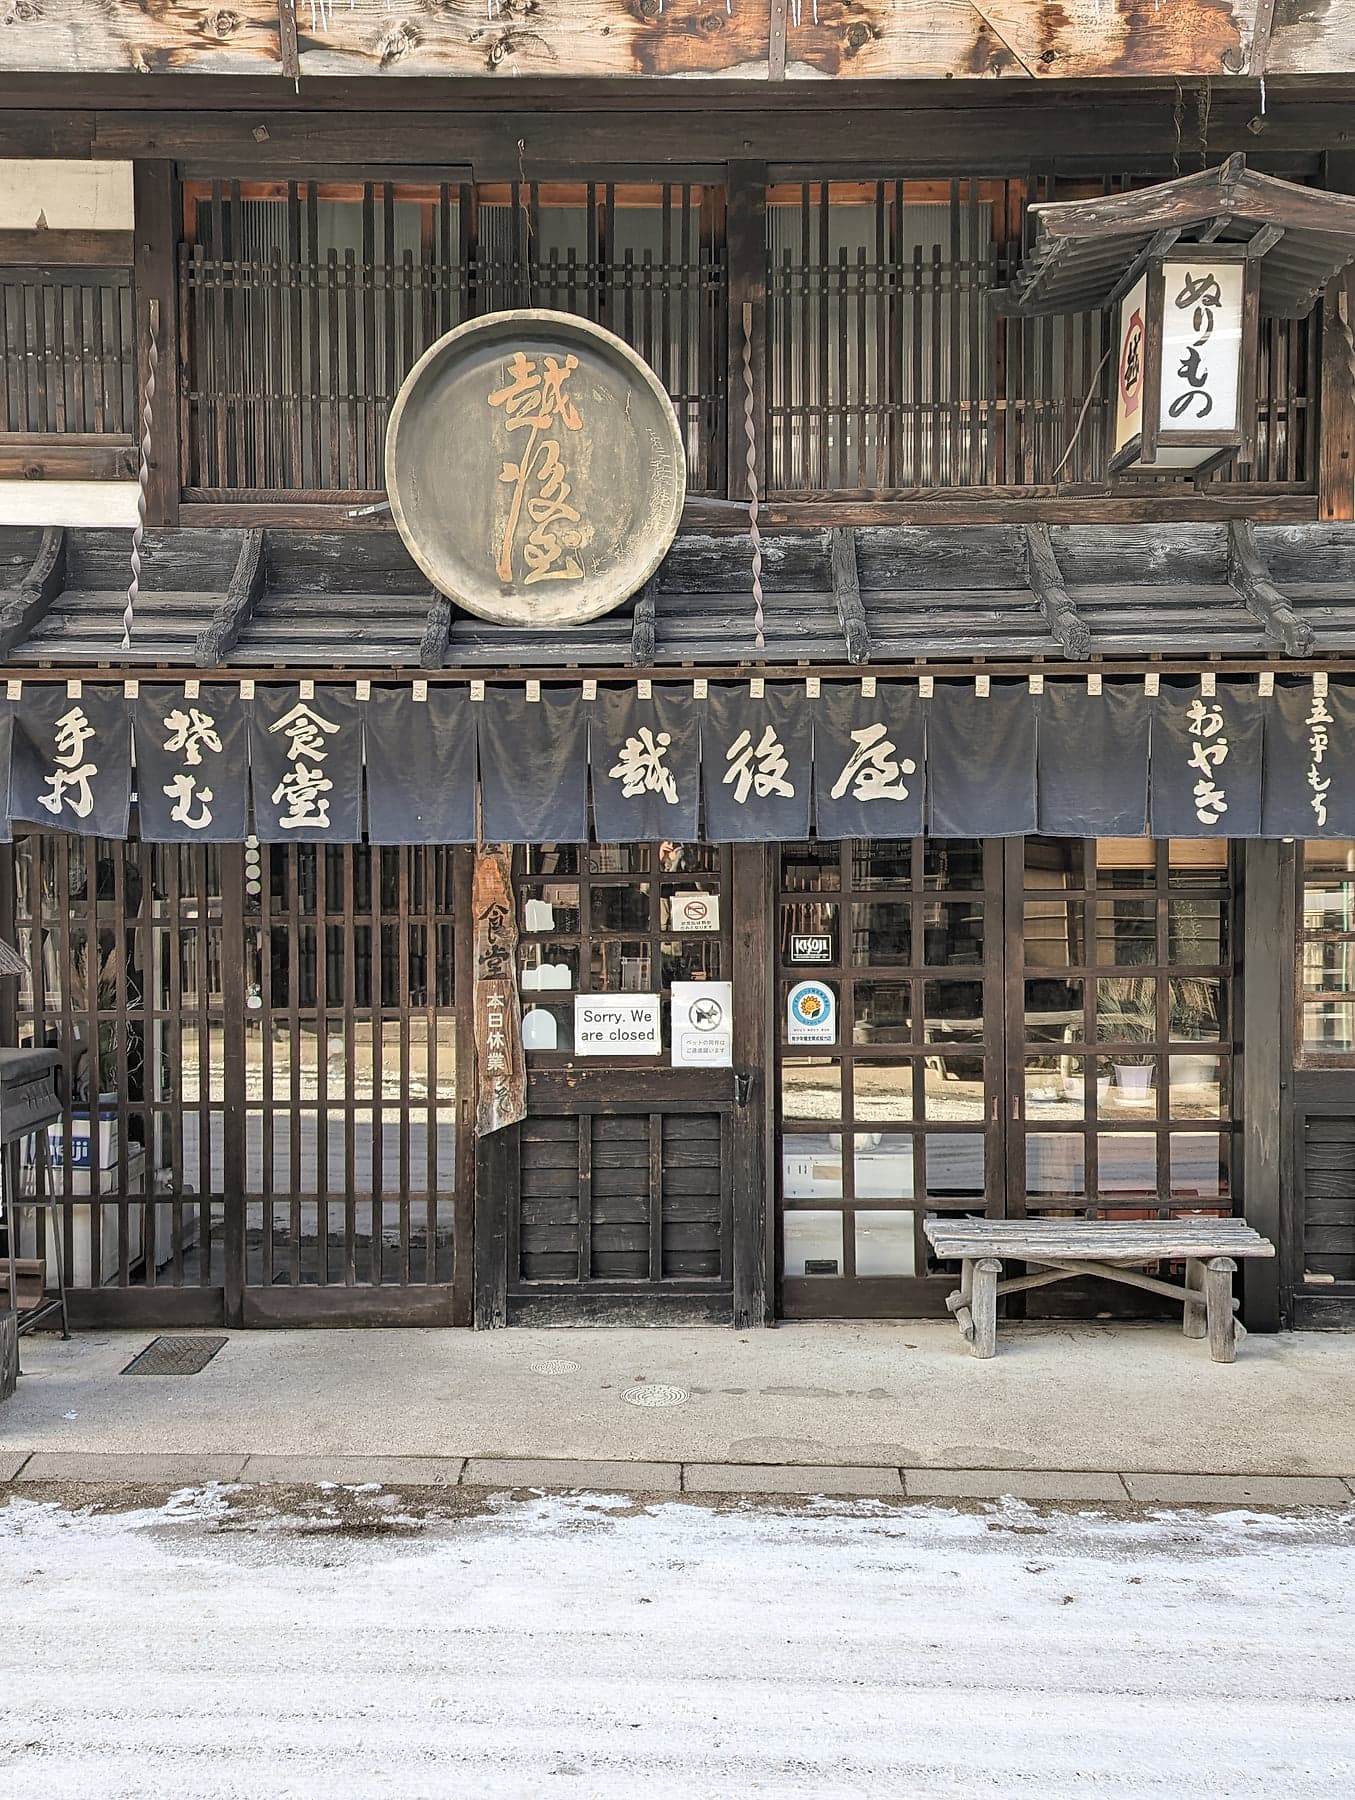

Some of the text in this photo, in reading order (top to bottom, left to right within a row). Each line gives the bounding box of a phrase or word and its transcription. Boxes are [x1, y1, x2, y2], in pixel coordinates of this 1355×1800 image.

[1168, 271, 1223, 418] ぬりもの
[37, 706, 98, 818] 手打
[267, 703, 341, 829] 食堂
[609, 723, 916, 804] 越後屋
[1186, 699, 1229, 825] おやき
[1305, 697, 1335, 827] 五平もち
[486, 993, 505, 1071] 本日休業
[581, 1028, 655, 1041] are closed
[583, 1010, 652, 1024] Sorry. We
